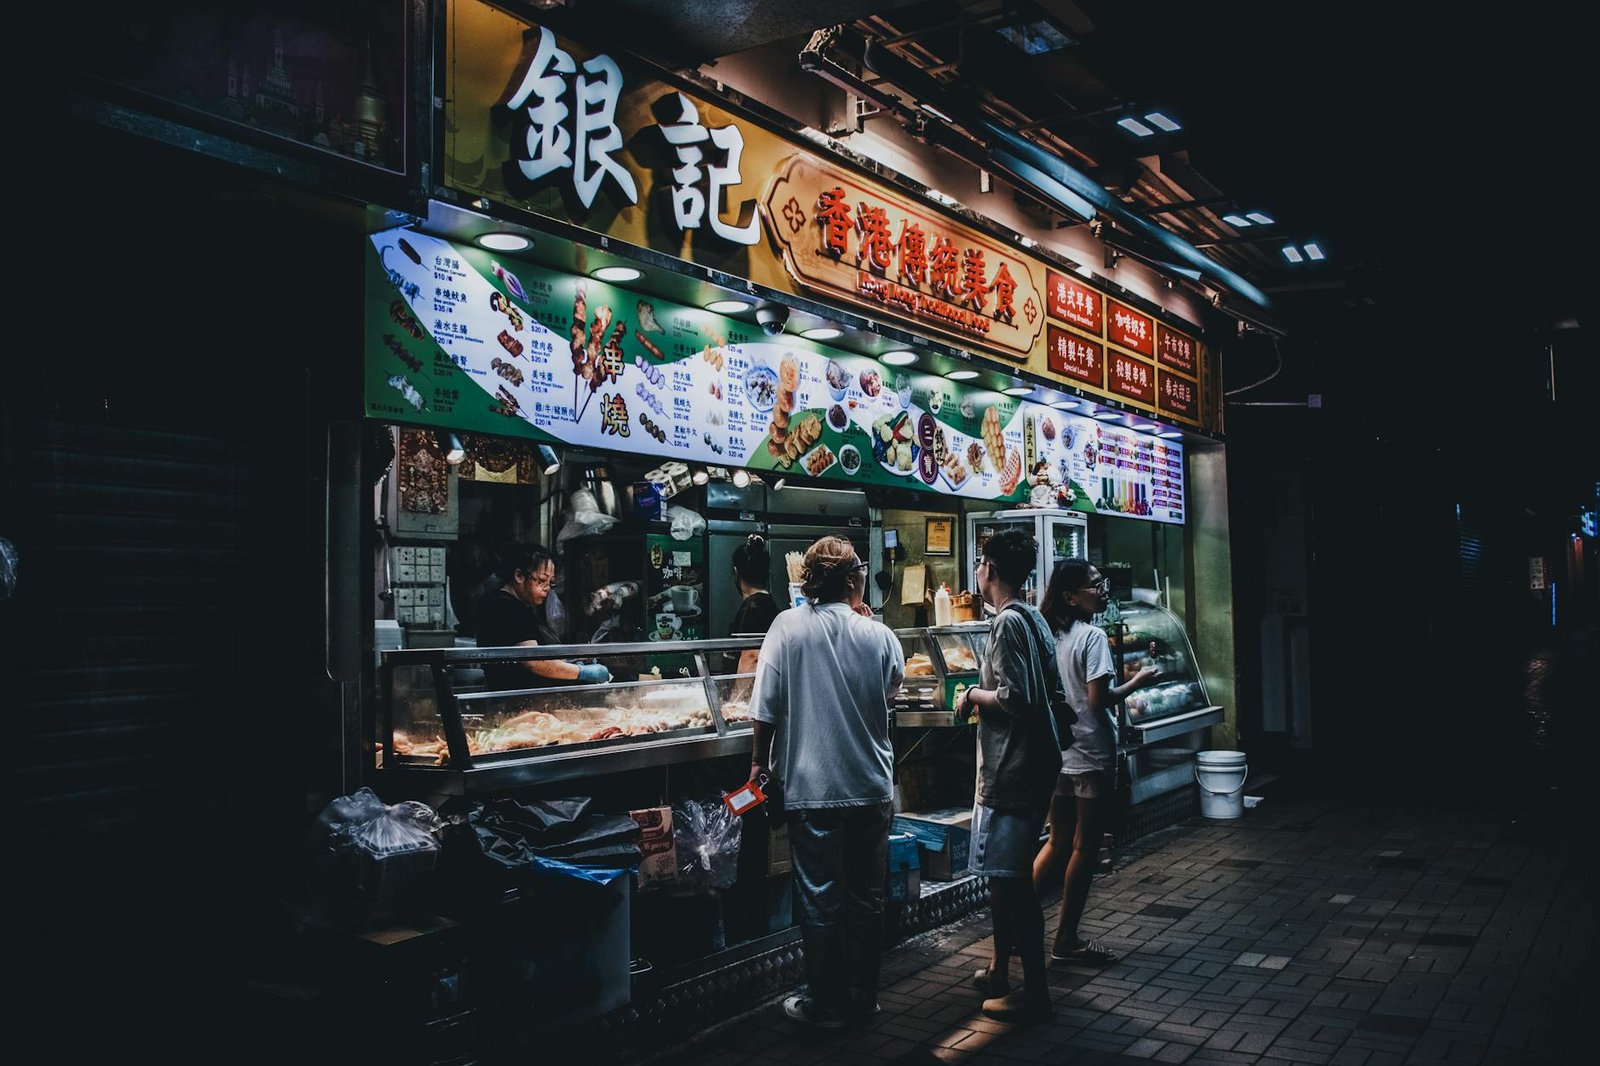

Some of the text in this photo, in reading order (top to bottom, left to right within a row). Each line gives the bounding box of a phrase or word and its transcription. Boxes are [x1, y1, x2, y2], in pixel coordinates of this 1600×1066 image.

[507, 26, 761, 245] 銀記
[815, 187, 1018, 320] 香港傳統美食
[1056, 281, 1093, 316] 港式早餐
[1056, 305, 1066, 317] Hong
[1067, 309, 1076, 322] Kong
[1115, 311, 1146, 340] 咖啡奶茶
[1057, 336, 1094, 368] 精製午餐
